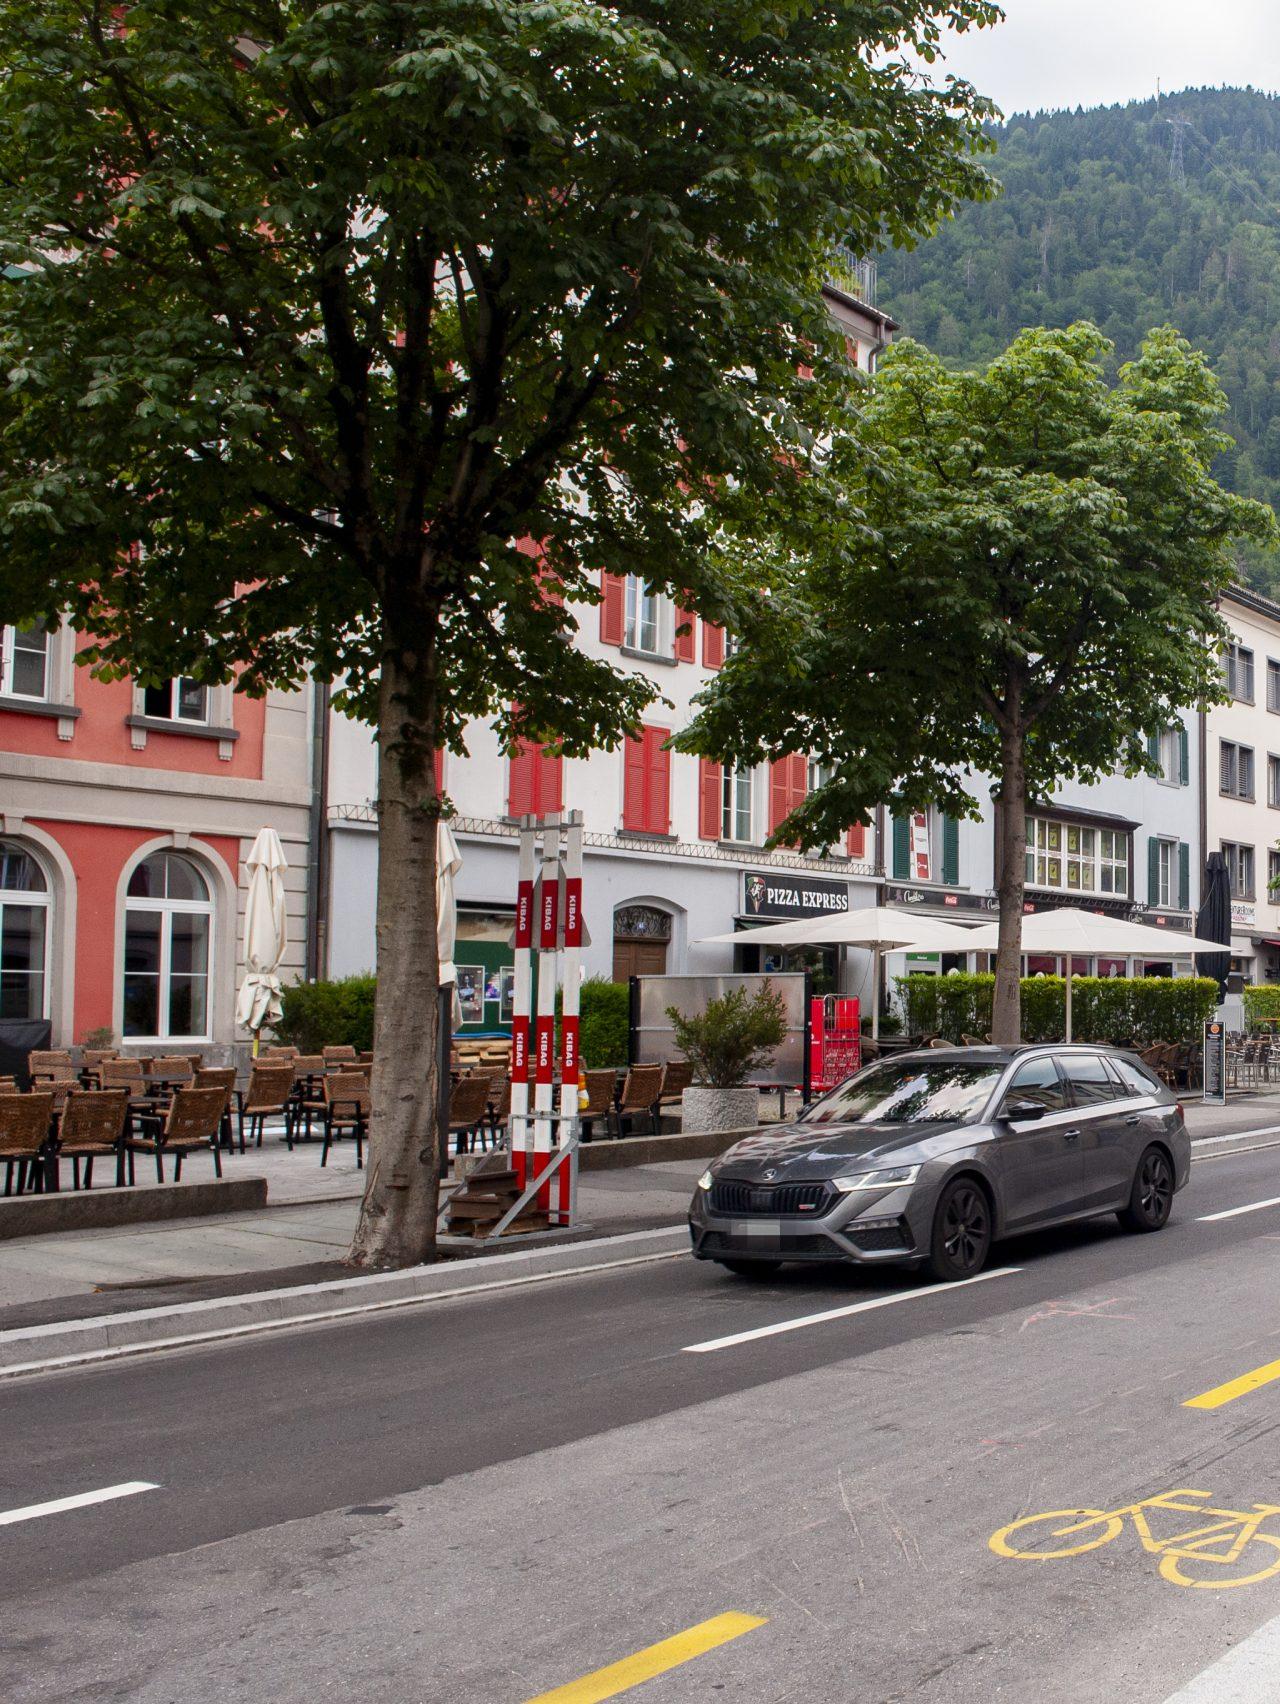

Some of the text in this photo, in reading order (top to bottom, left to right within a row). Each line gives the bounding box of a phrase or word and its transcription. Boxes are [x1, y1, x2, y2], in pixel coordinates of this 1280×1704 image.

[519, 897, 527, 931] KIBAG
[544, 896, 552, 931] KIBAG
[568, 895, 576, 930] KIBAG
[766, 887, 848, 910] PIZZA EXPRESS
[516, 1032, 524, 1067] KIBAG
[540, 1032, 548, 1067] KIBAG
[565, 1032, 573, 1067] KIBAG
